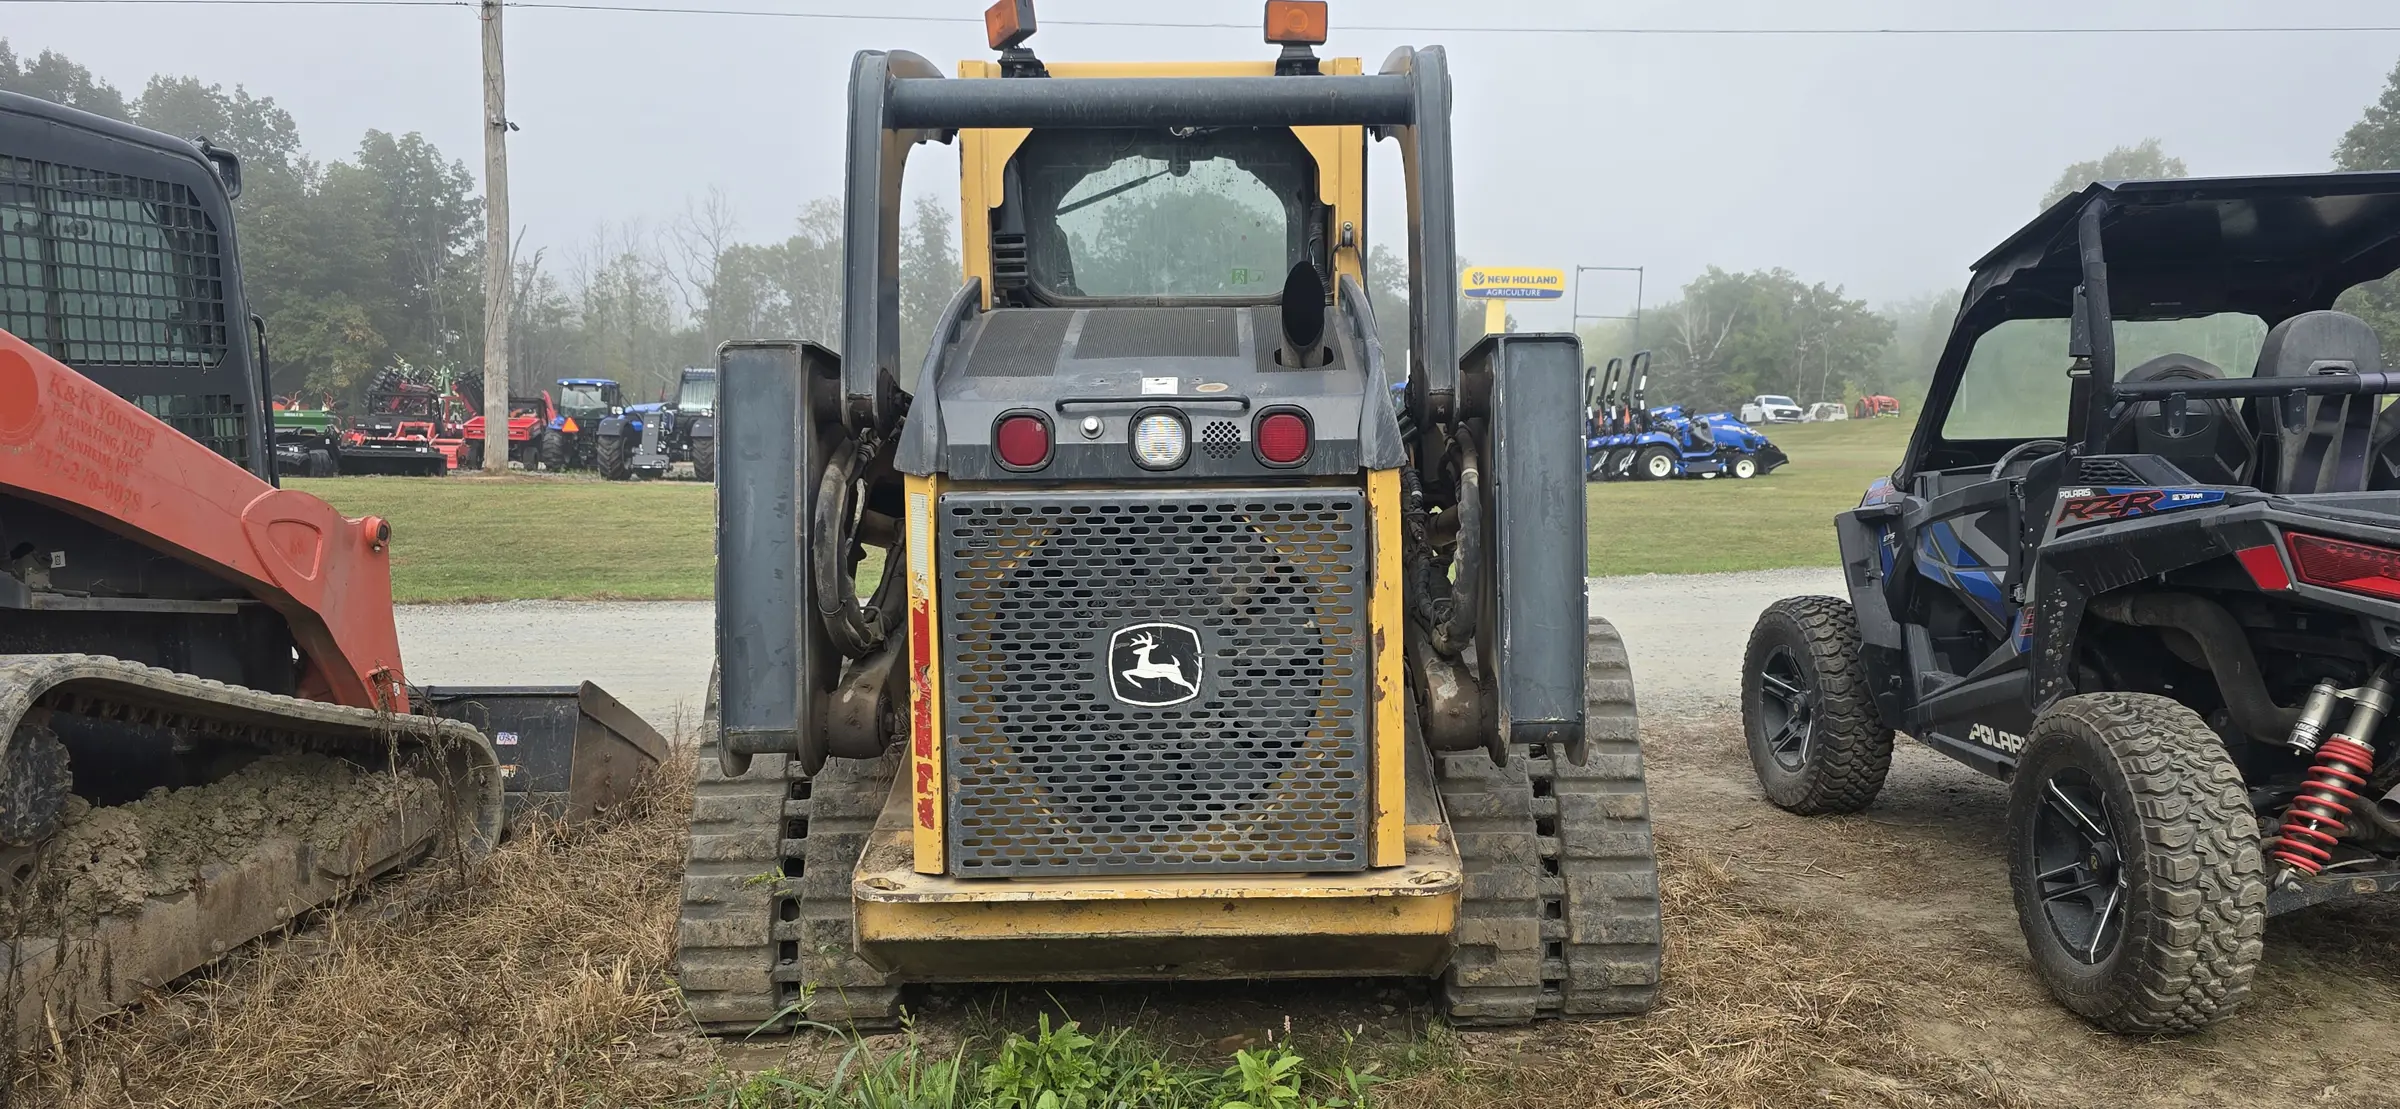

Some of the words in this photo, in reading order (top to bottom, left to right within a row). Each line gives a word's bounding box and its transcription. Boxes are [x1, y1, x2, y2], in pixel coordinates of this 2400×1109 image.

[1488, 275, 1510, 284] NEW
[1512, 275, 1558, 285] HOLLAND
[1486, 288, 1541, 297] AGRICULTURE
[2059, 488, 2091, 499] POLARIS
[2055, 490, 2166, 526] RZR
[1969, 723, 2026, 754] POLAR
